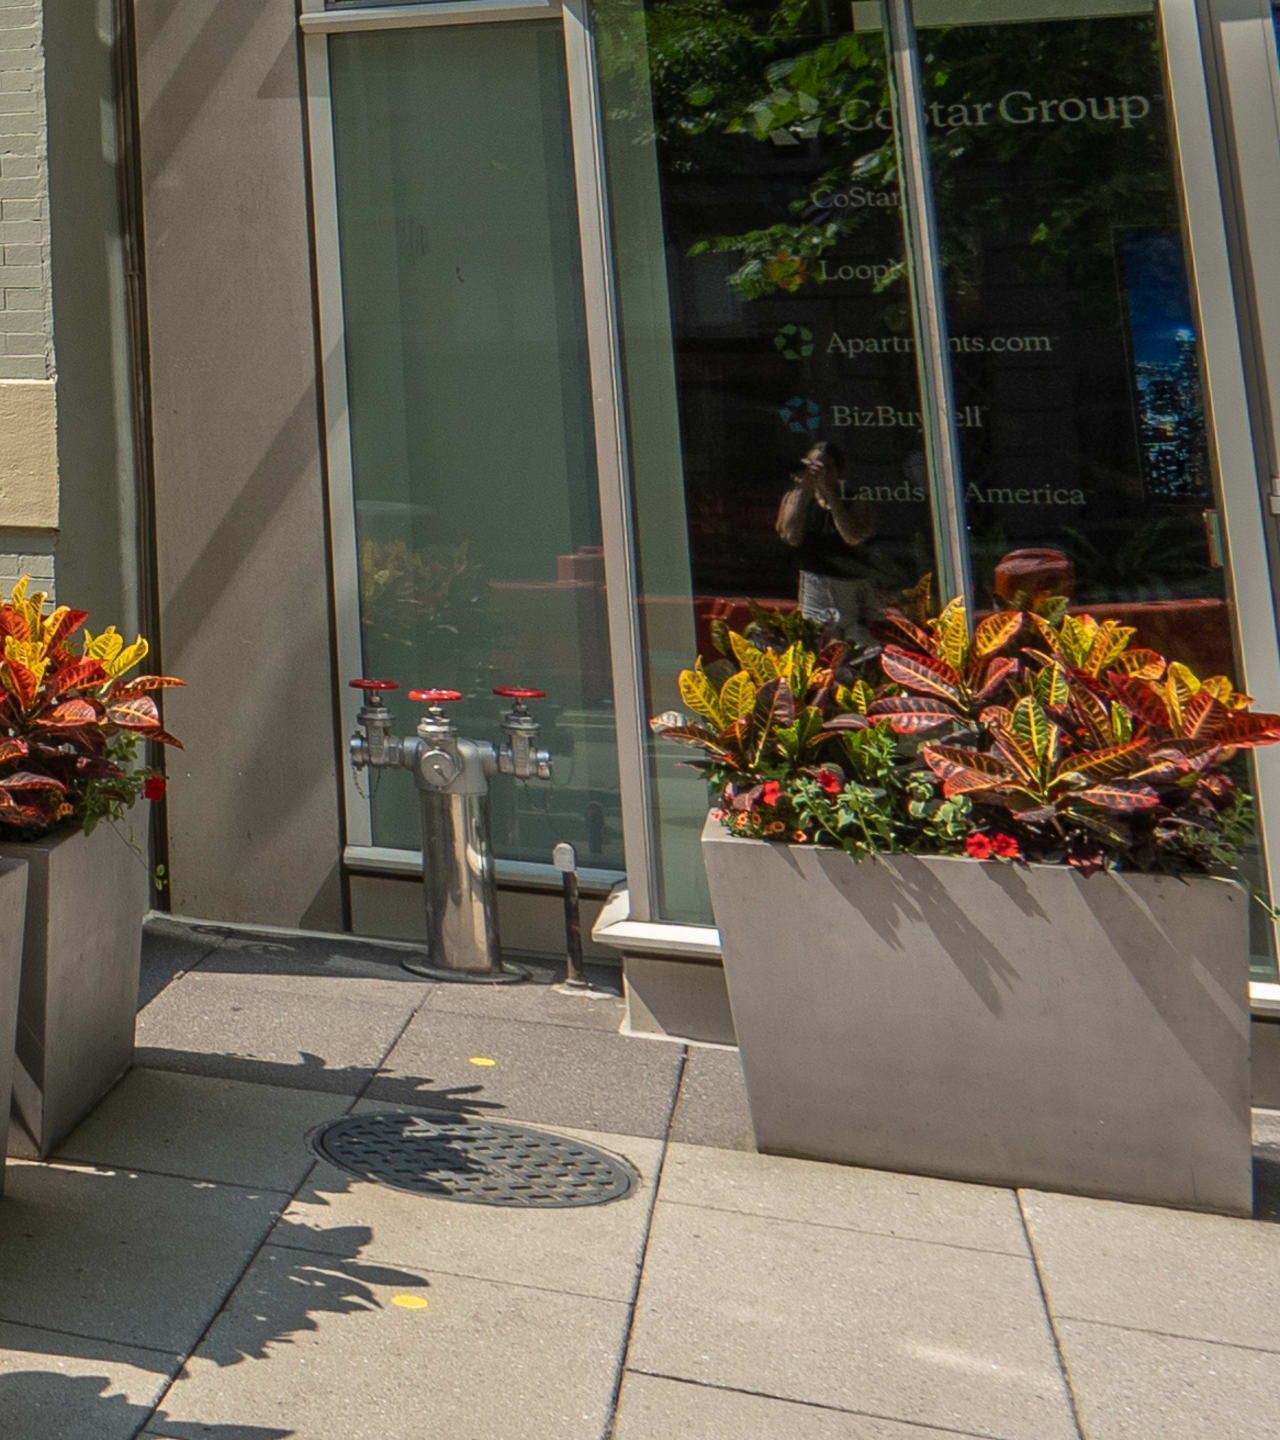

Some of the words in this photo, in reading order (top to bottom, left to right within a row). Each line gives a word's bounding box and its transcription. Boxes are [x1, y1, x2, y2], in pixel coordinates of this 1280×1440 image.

[839, 98, 992, 132] Cotar
[999, 90, 1151, 129] Group
[826, 332, 1054, 359] Apartnts.com
[831, 405, 984, 435] BizBuyell
[839, 478, 926, 503] Lands
[964, 482, 1088, 506] America
